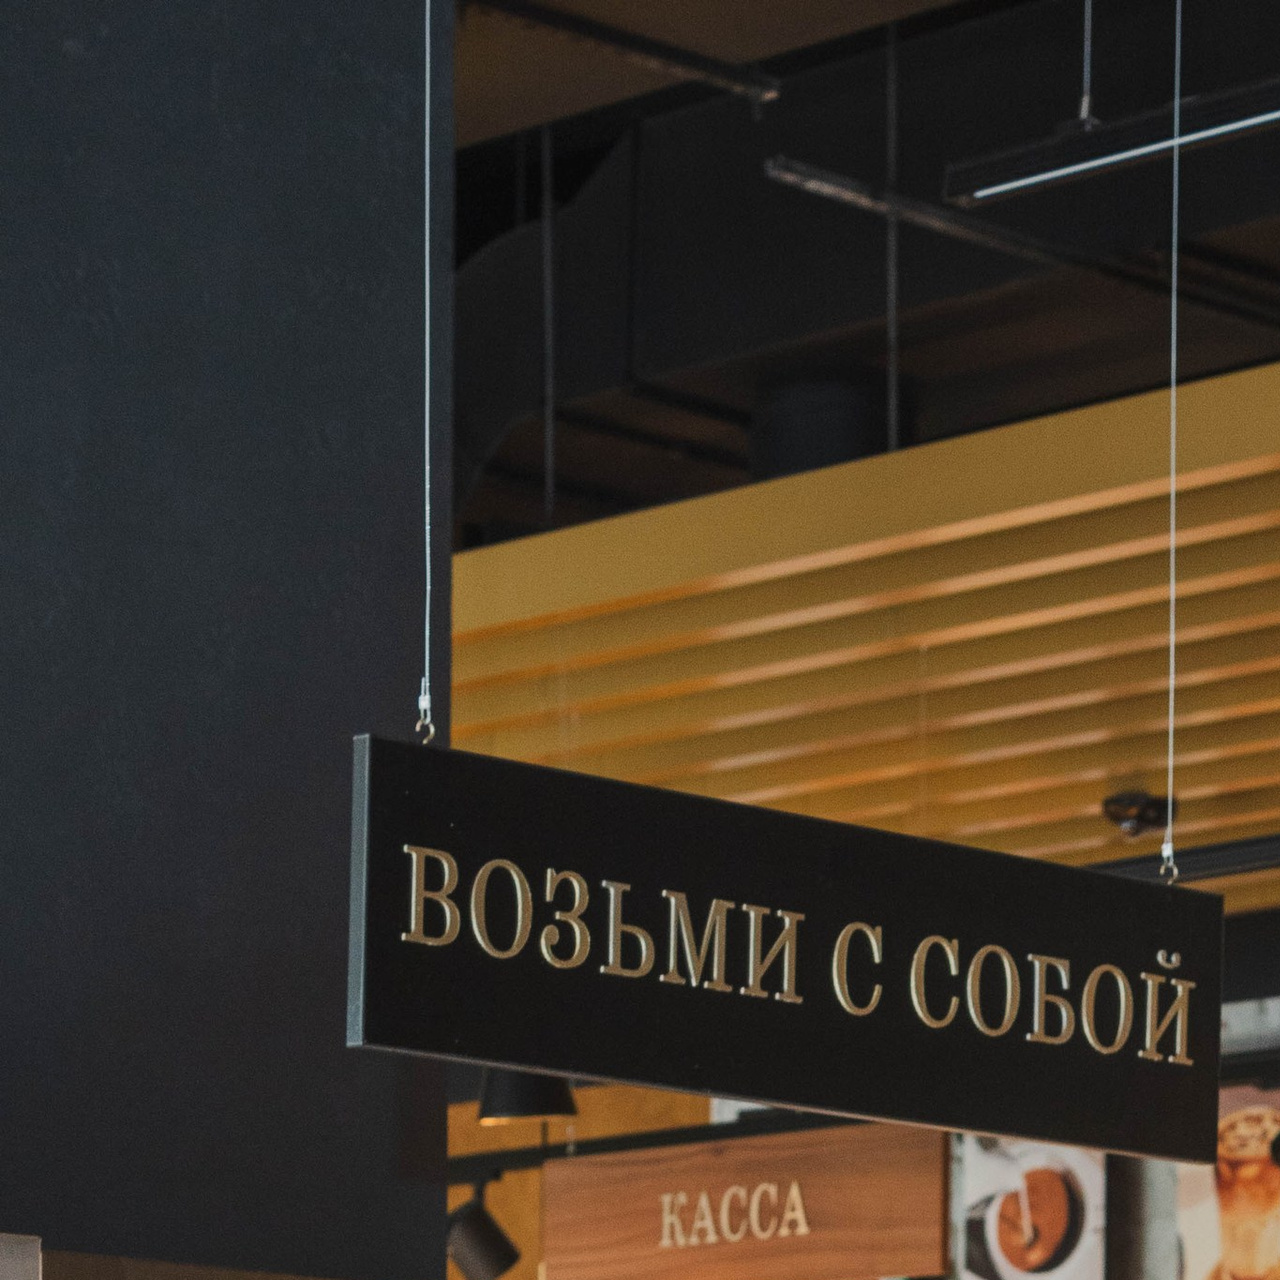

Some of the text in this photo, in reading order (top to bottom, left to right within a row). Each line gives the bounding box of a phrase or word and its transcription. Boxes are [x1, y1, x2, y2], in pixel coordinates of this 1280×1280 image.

[401, 844, 1195, 1066] ВОЗЬМИ С СОБОЙ
[658, 1182, 810, 1248] КАССА
